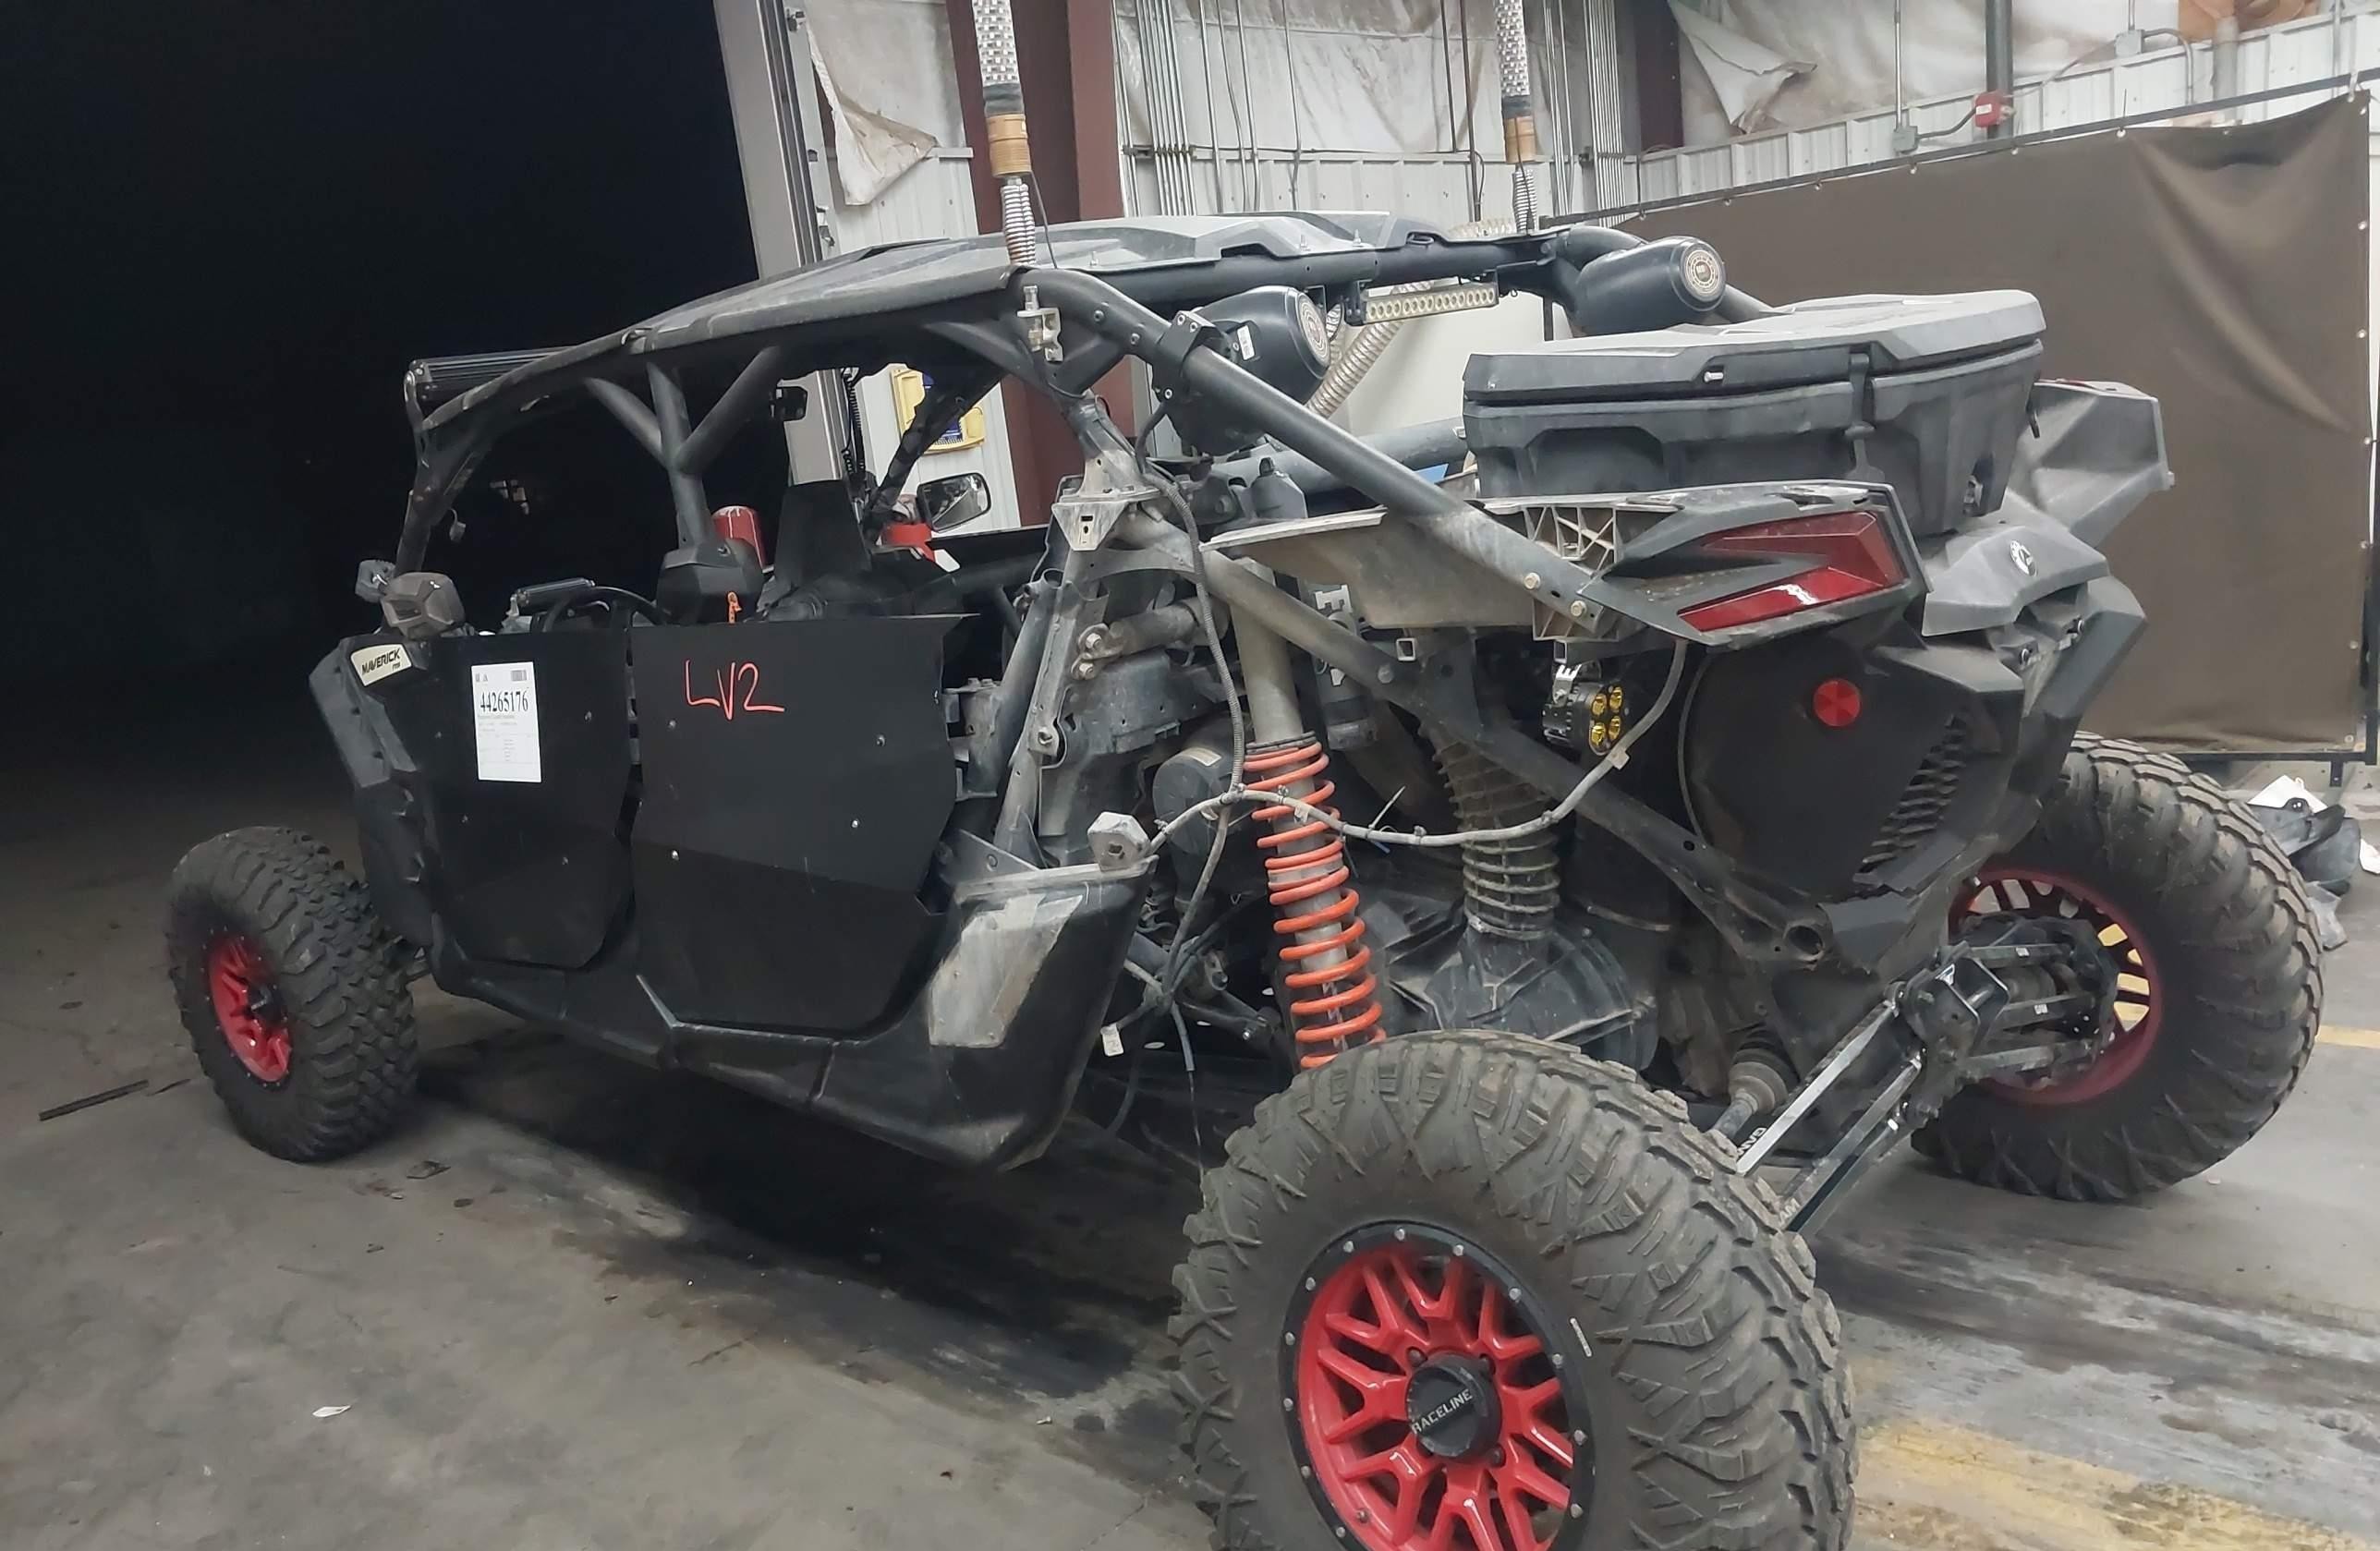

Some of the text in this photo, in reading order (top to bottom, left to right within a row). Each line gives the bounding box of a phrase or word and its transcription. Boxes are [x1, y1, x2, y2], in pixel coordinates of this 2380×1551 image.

[361, 648, 401, 674] MAVERICK
[480, 690, 529, 712] 44265176
[685, 660, 785, 721] LV2
[1411, 1388, 1474, 1435] RACELINE
